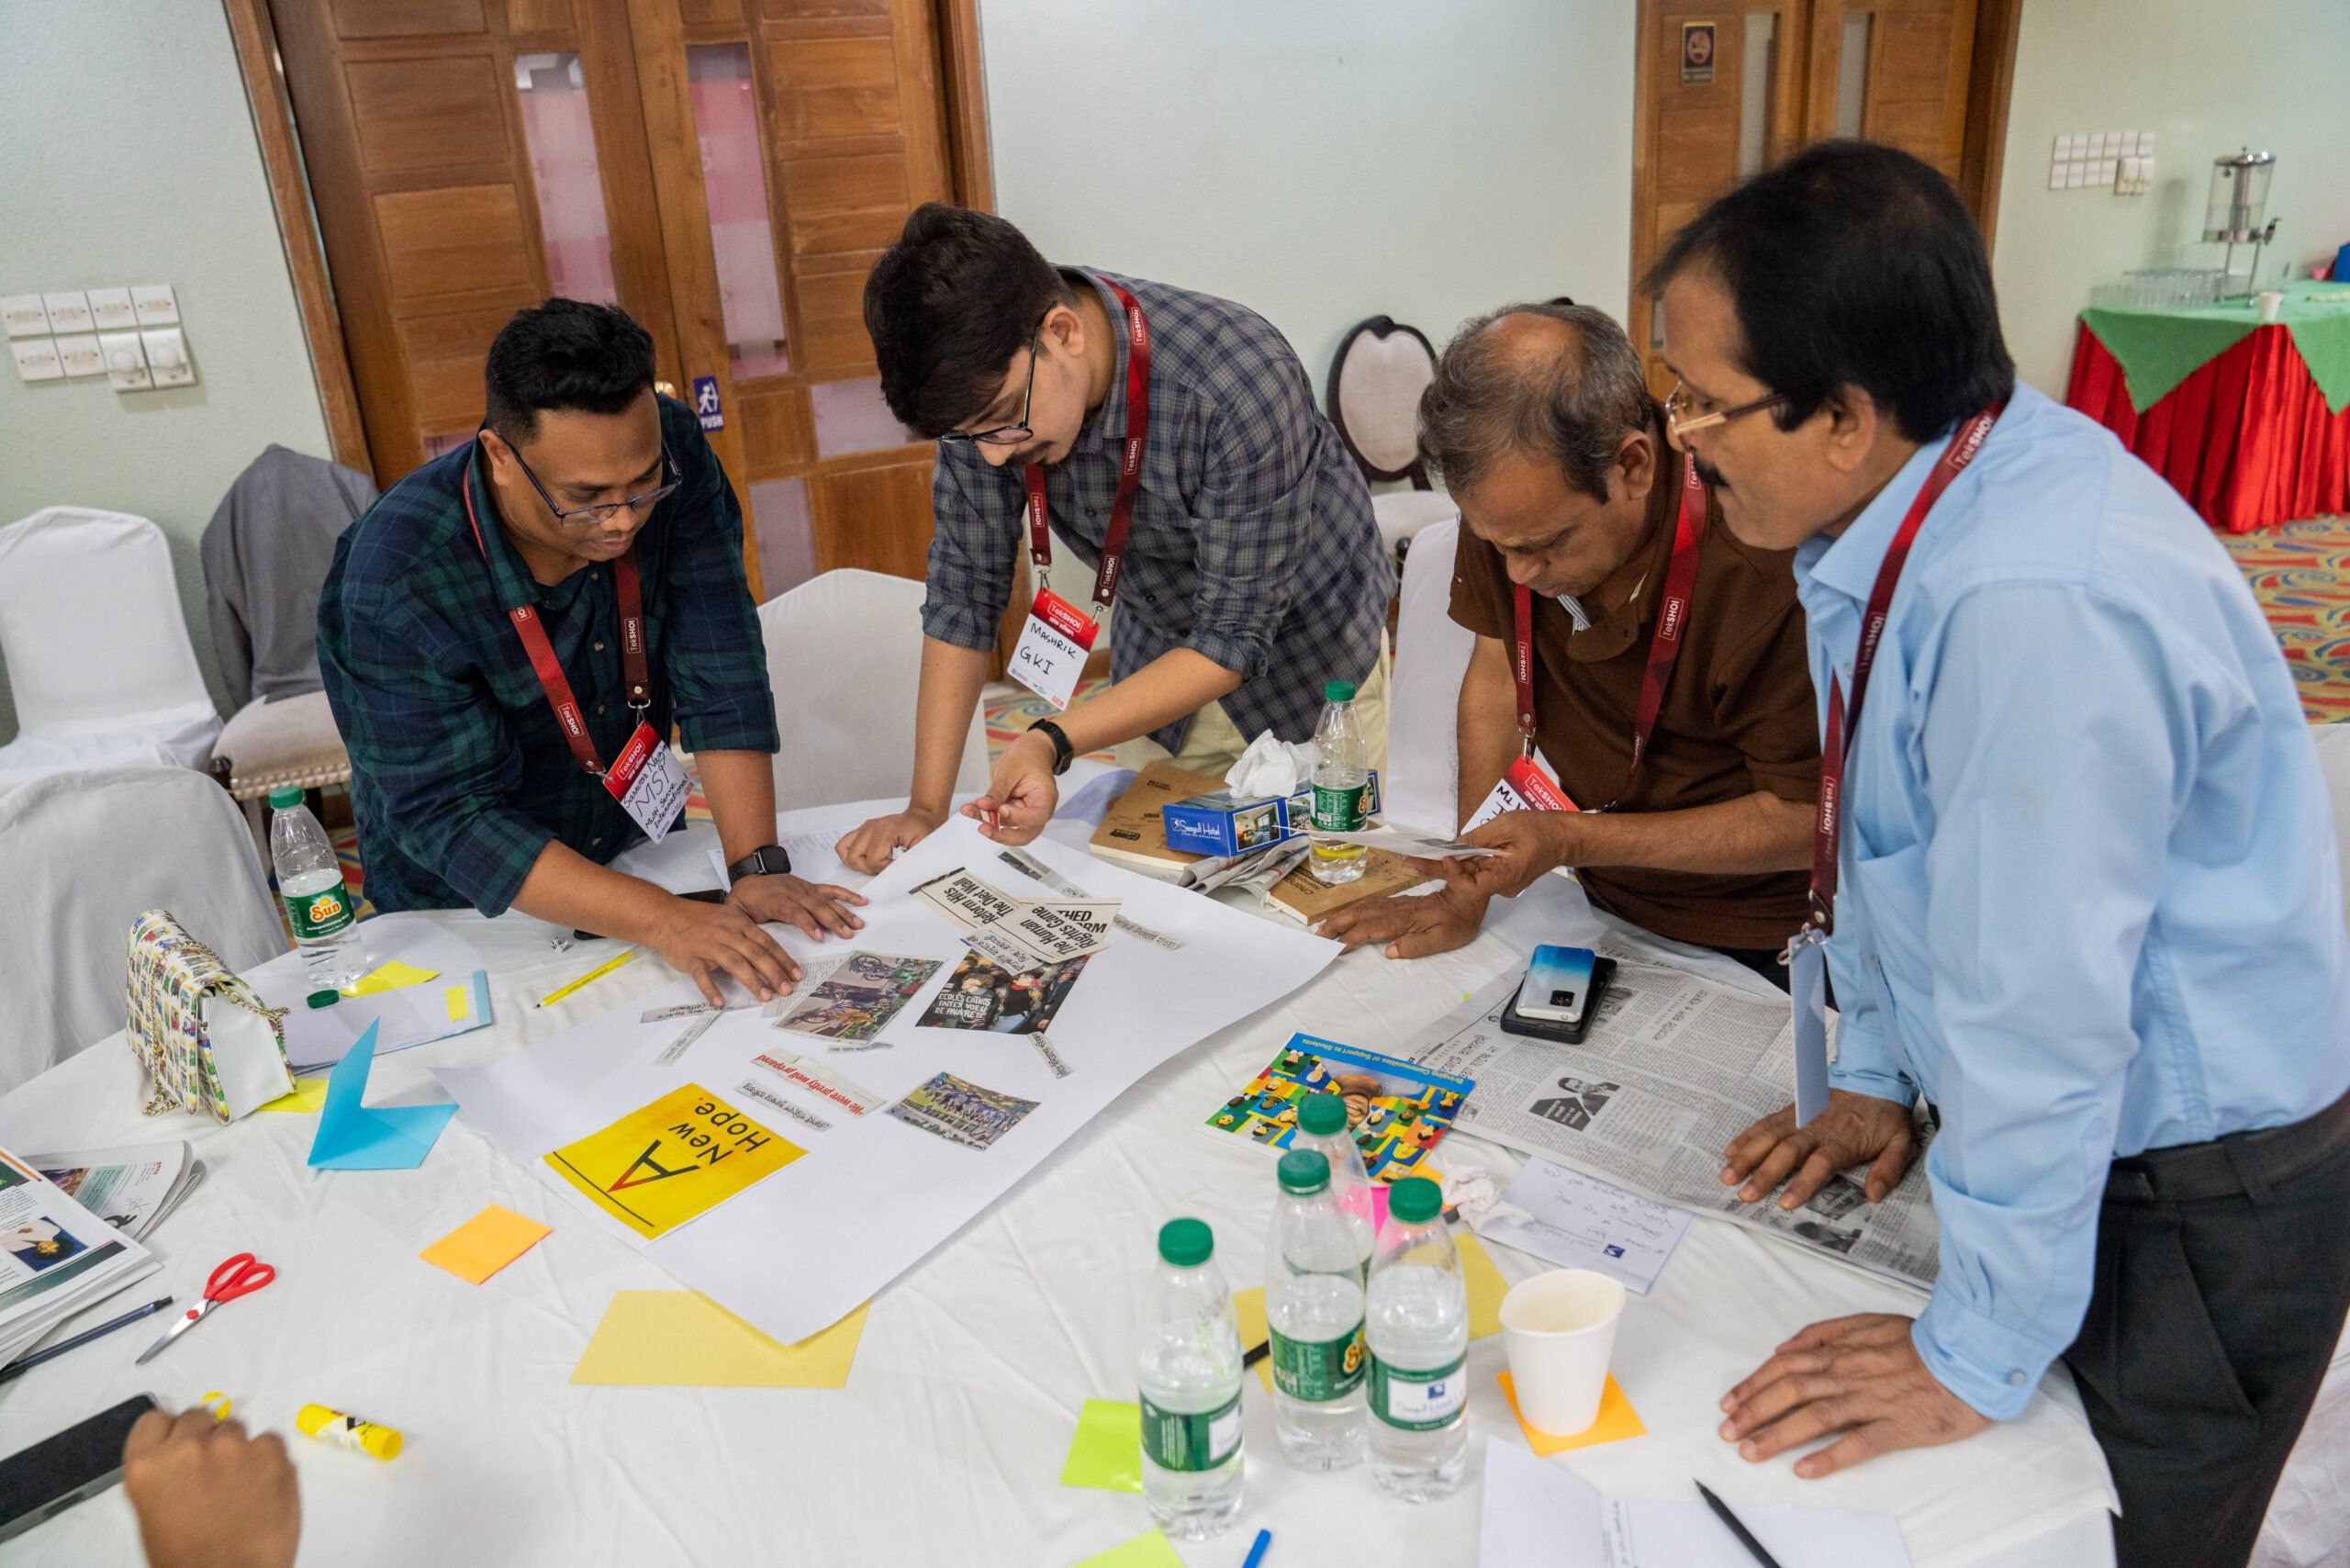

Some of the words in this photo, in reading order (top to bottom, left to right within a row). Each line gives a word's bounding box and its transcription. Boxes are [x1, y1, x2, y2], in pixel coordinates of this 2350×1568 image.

[1134, 308, 1143, 342] TekSHOI
[1127, 440, 1137, 472] TekSHOI
[1034, 496, 1042, 526] TekSHOI
[1103, 557, 1115, 586] TekSHOI
[1051, 604, 1081, 630] TekSHOI
[1662, 599, 1679, 637] TekSHOI
[1030, 622, 1076, 659] MASHRIK
[1020, 645, 1055, 675] GKI
[562, 706, 581, 735] TekSHOI
[620, 742, 643, 776] TekSHOI
[1529, 778, 1561, 811] TekSHO
[1179, 819, 1203, 834] Seagull
[1203, 822, 1221, 835] Hotel
[945, 887, 968, 904] Hits
[952, 877, 978, 893] Wall
[973, 890, 998, 906] Diet
[993, 901, 1014, 917] The
[310, 902, 341, 923] Sun
[962, 900, 999, 924] Reform
[1032, 906, 1066, 929] Game
[1020, 919, 1058, 945] Human
[1059, 924, 1099, 949] Rights
[1055, 940, 1079, 956] The
[938, 1000, 964, 1008] FAITES
[1302, 1037, 1334, 1050] Students
[1342, 1047, 1372, 1061] Support
[755, 1054, 797, 1077] prepared
[789, 1070, 811, 1083] well
[1381, 1058, 1431, 1076] Communities
[808, 1079, 835, 1095] pretty
[1431, 1070, 1464, 1085] Bringing
[830, 1091, 852, 1106] were
[694, 1096, 771, 1153] Hope.
[667, 1123, 733, 1166] New
[606, 1138, 701, 1193] A
